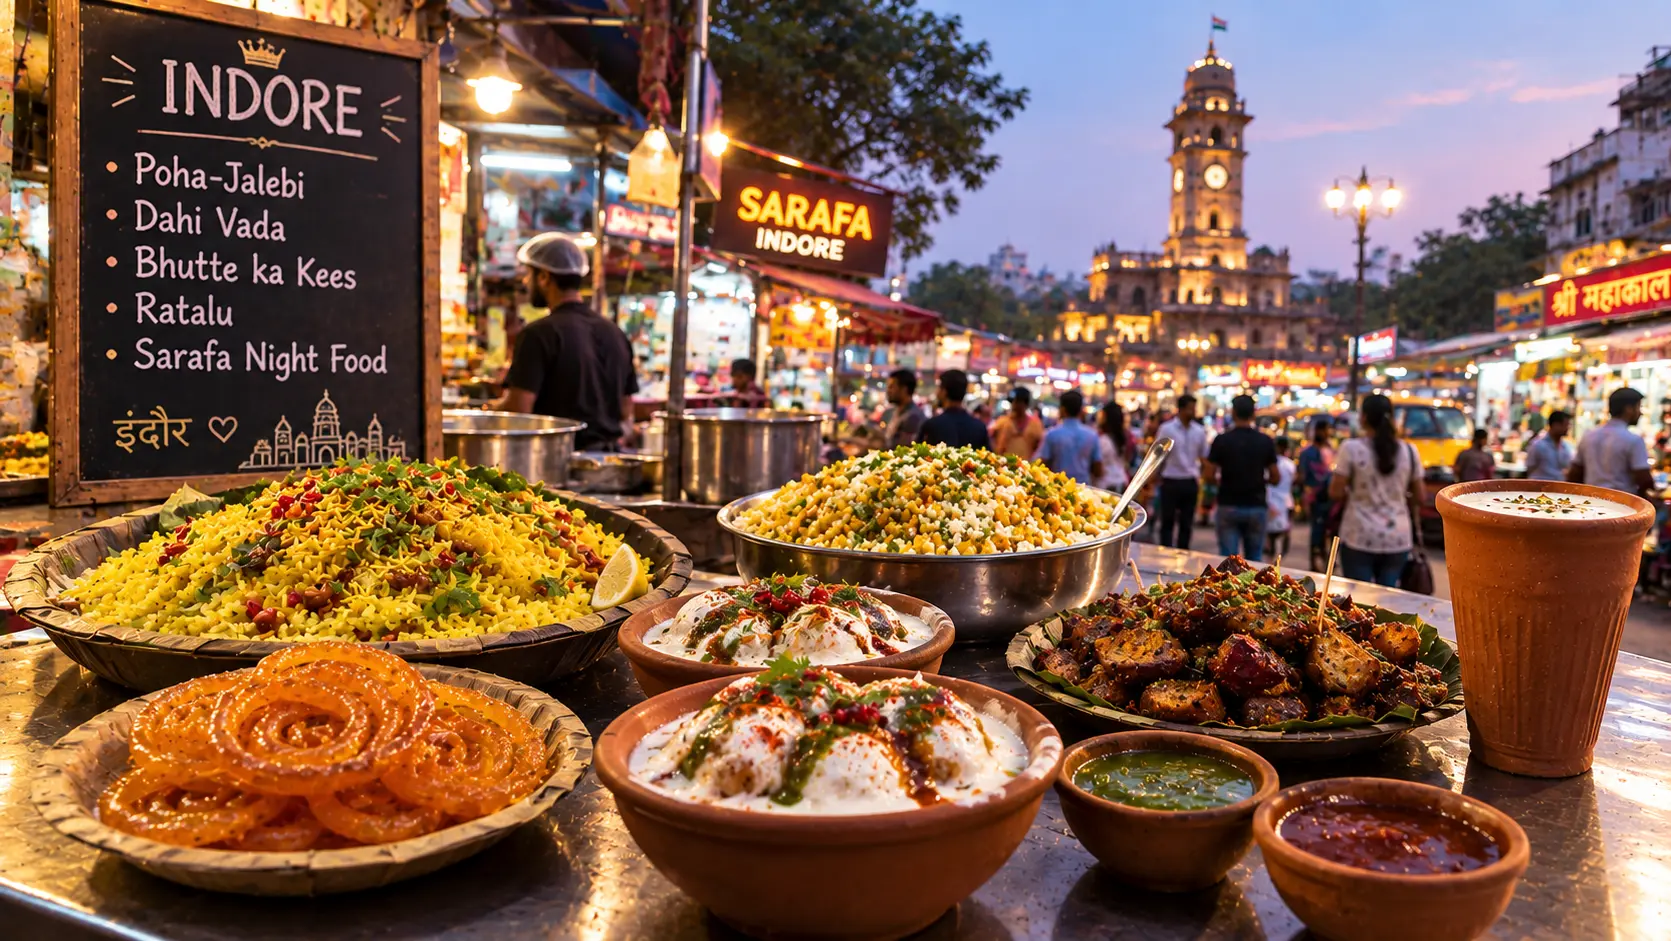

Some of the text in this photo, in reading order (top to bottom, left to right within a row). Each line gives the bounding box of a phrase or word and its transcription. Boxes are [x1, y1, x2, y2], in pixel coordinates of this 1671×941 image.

[162, 59, 363, 137] INDORE
[135, 152, 305, 199] Poha-Jalebi
[134, 199, 286, 242] Dahi Vada
[737, 186, 873, 241] SARAFA
[755, 227, 846, 262] INDORE
[134, 245, 357, 290] Bhutte ka Kees
[135, 291, 233, 327] Ratalu
[1551, 279, 1579, 318] श्री
[133, 337, 388, 382] Sarafa Night Food
[112, 405, 193, 454] इंदौर
